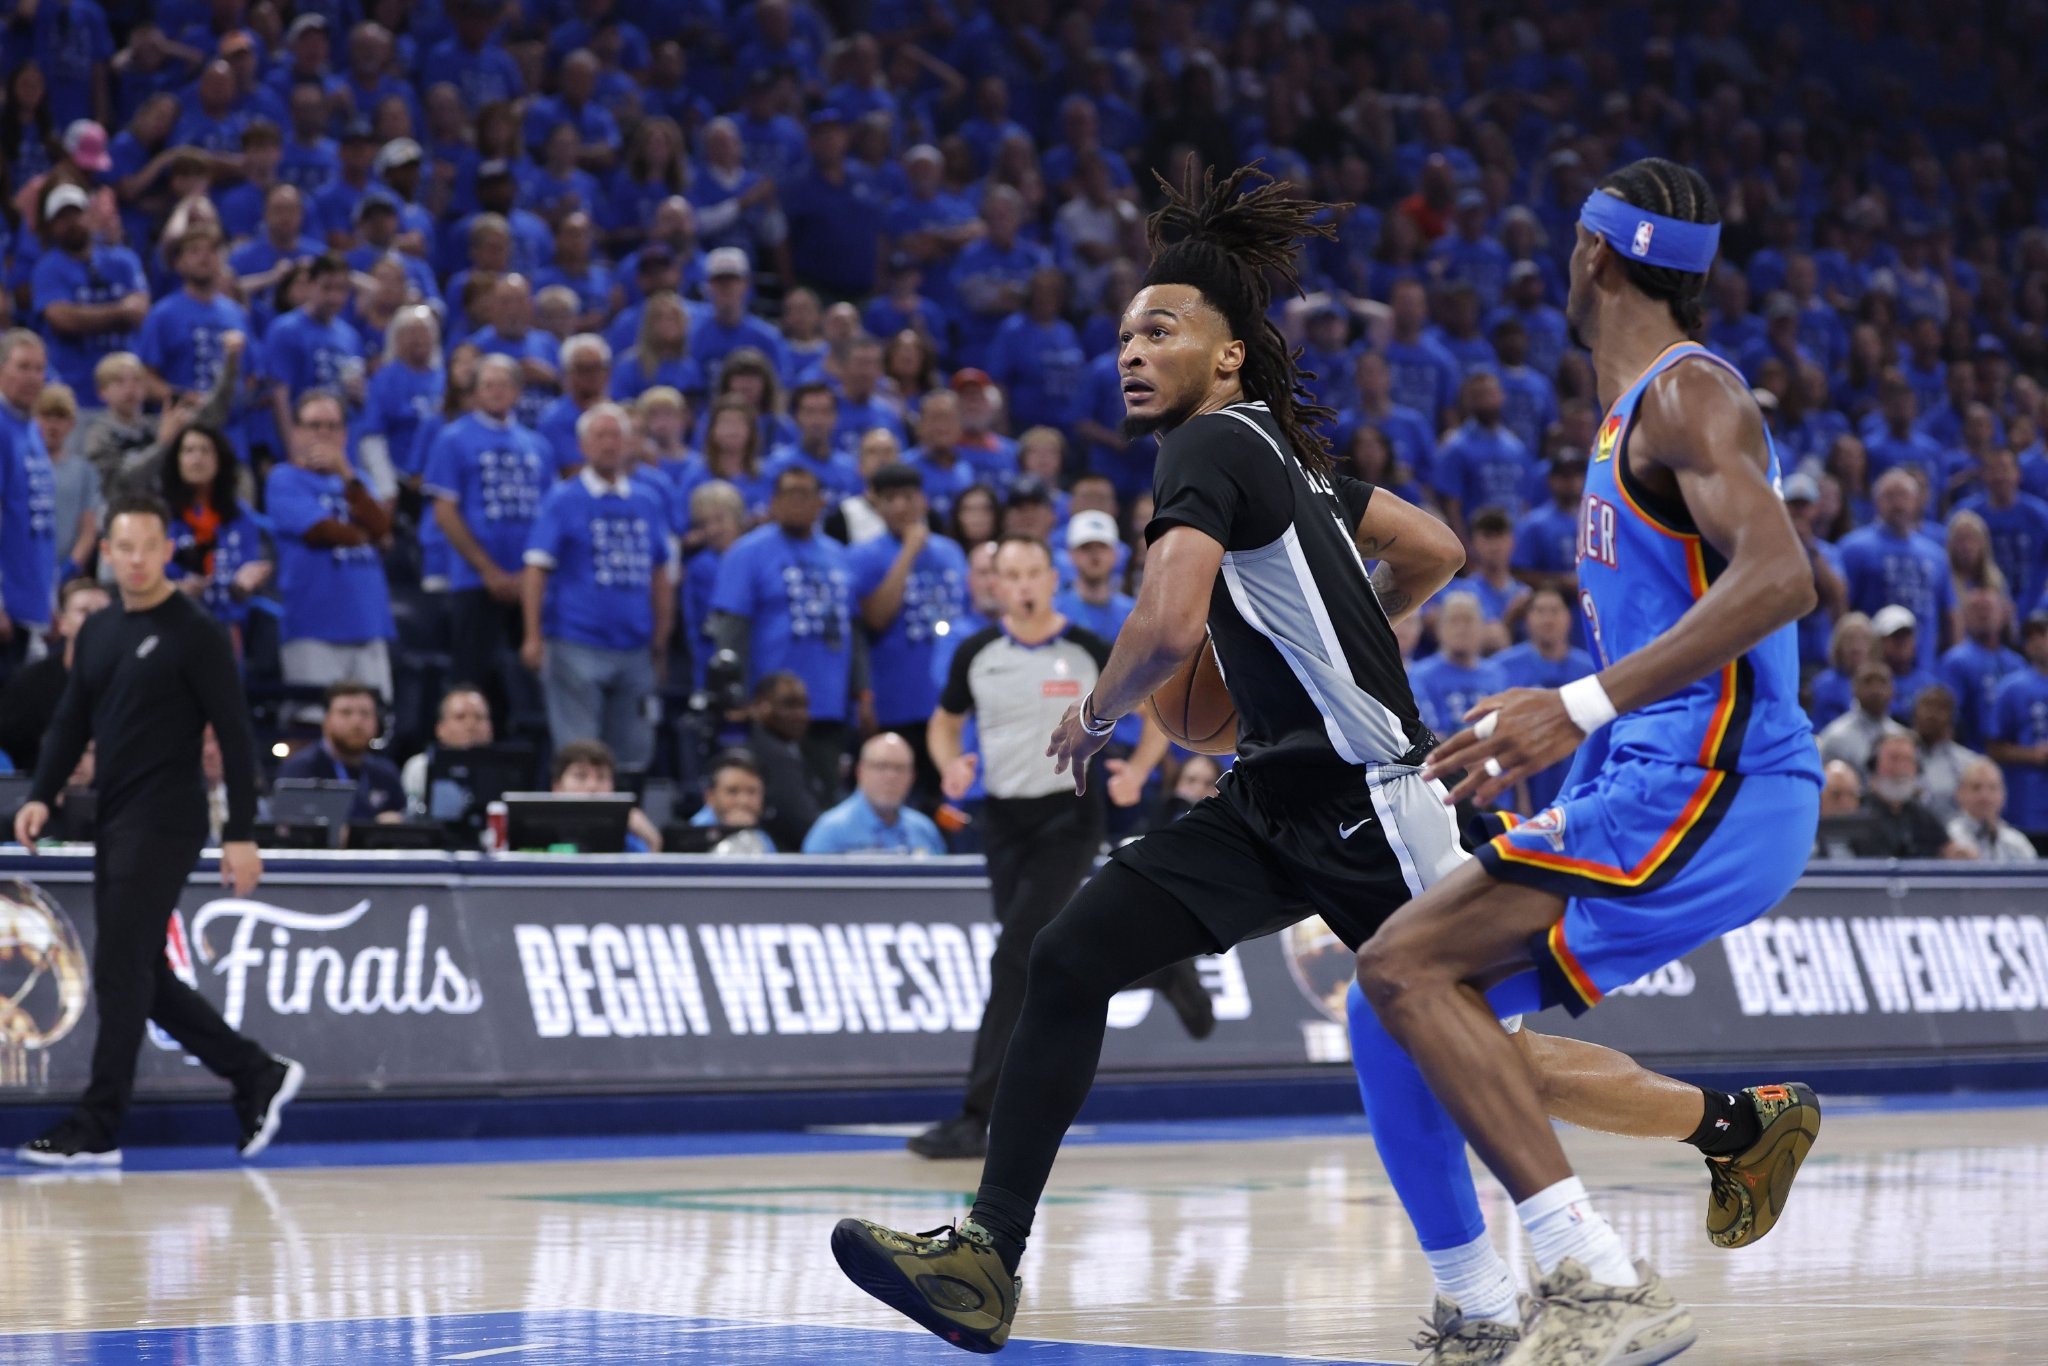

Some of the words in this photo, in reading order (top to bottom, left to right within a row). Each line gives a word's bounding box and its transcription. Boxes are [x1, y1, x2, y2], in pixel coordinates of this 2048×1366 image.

[191, 899, 483, 1031] Finals
[513, 922, 711, 1038] BEGIN
[1721, 915, 1869, 1016] BEGIN
